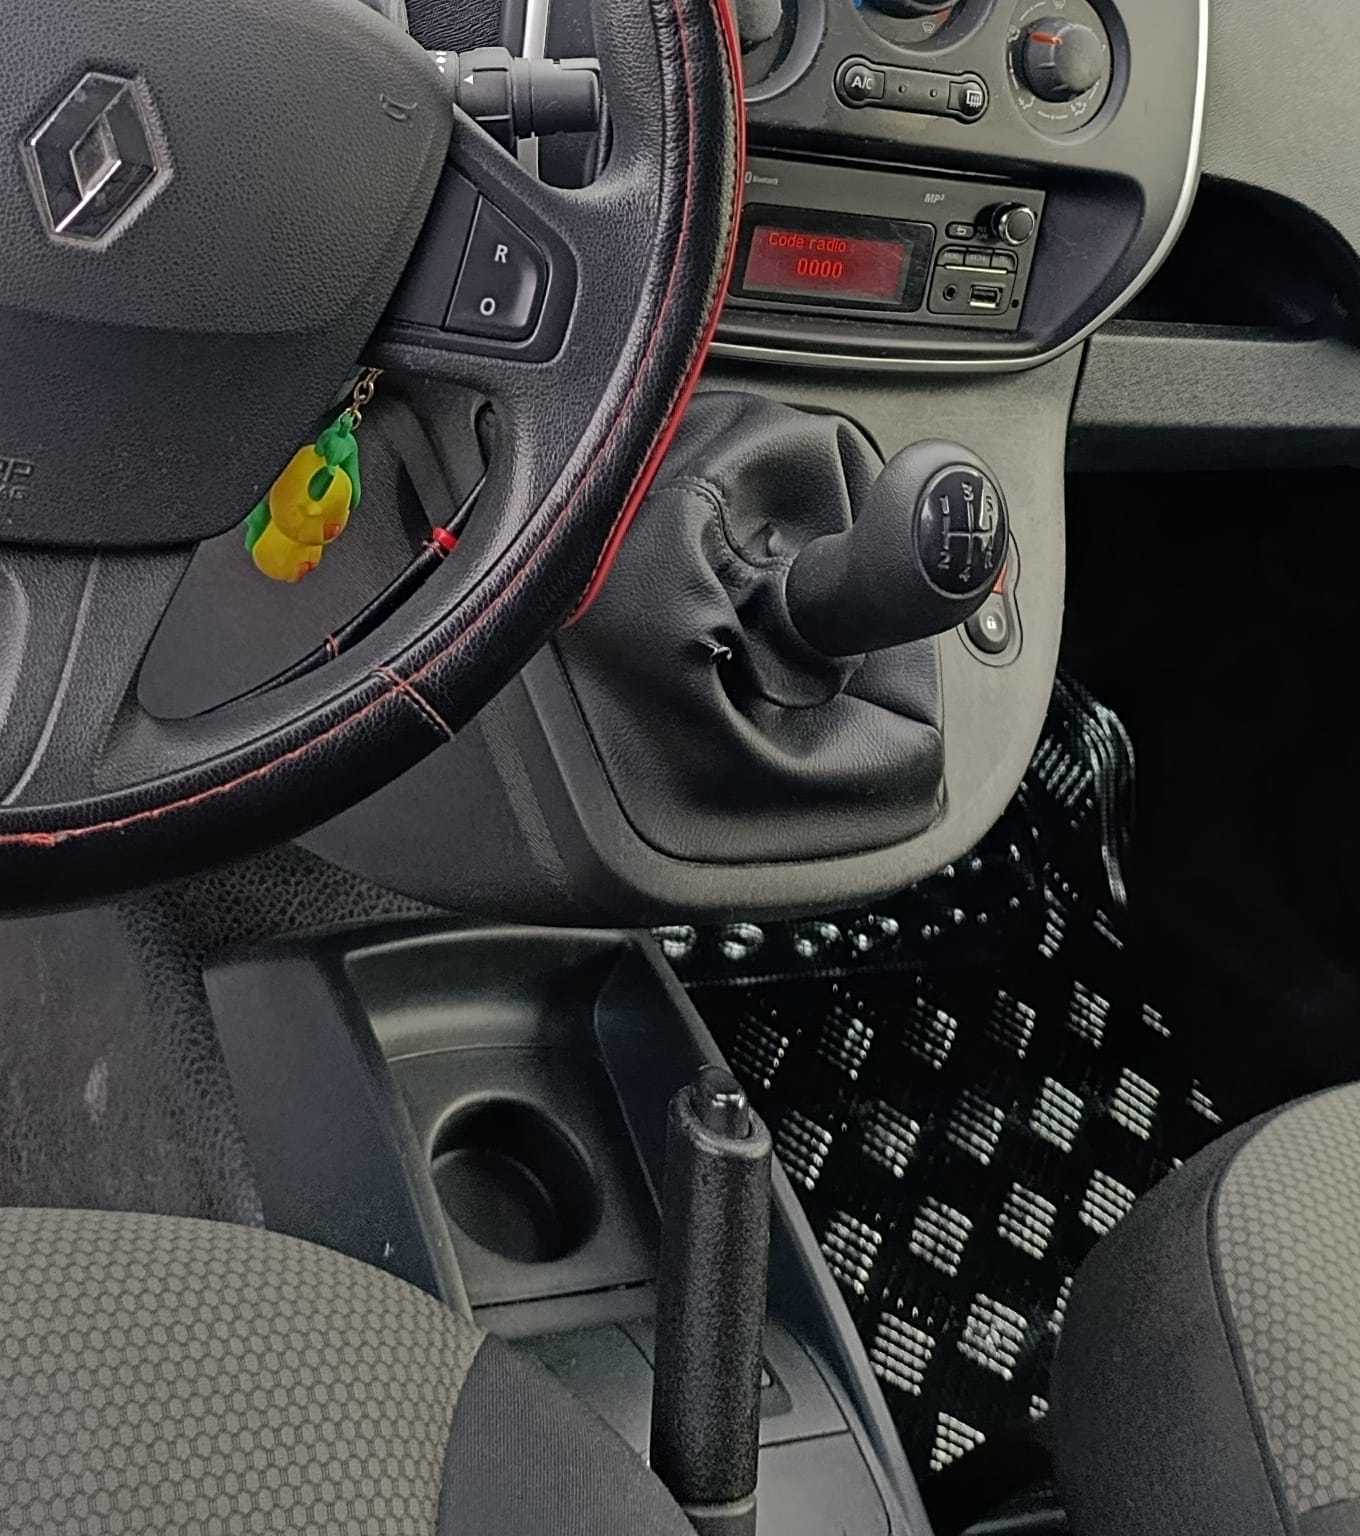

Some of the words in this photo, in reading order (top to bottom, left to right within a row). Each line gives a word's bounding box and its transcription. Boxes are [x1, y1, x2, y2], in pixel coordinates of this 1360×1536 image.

[851, 76, 873, 90] A/C
[768, 232, 805, 249] Code
[808, 236, 848, 253] radio
[495, 244, 508, 263] R
[797, 258, 843, 279] 0000
[938, 551, 951, 570] 2
